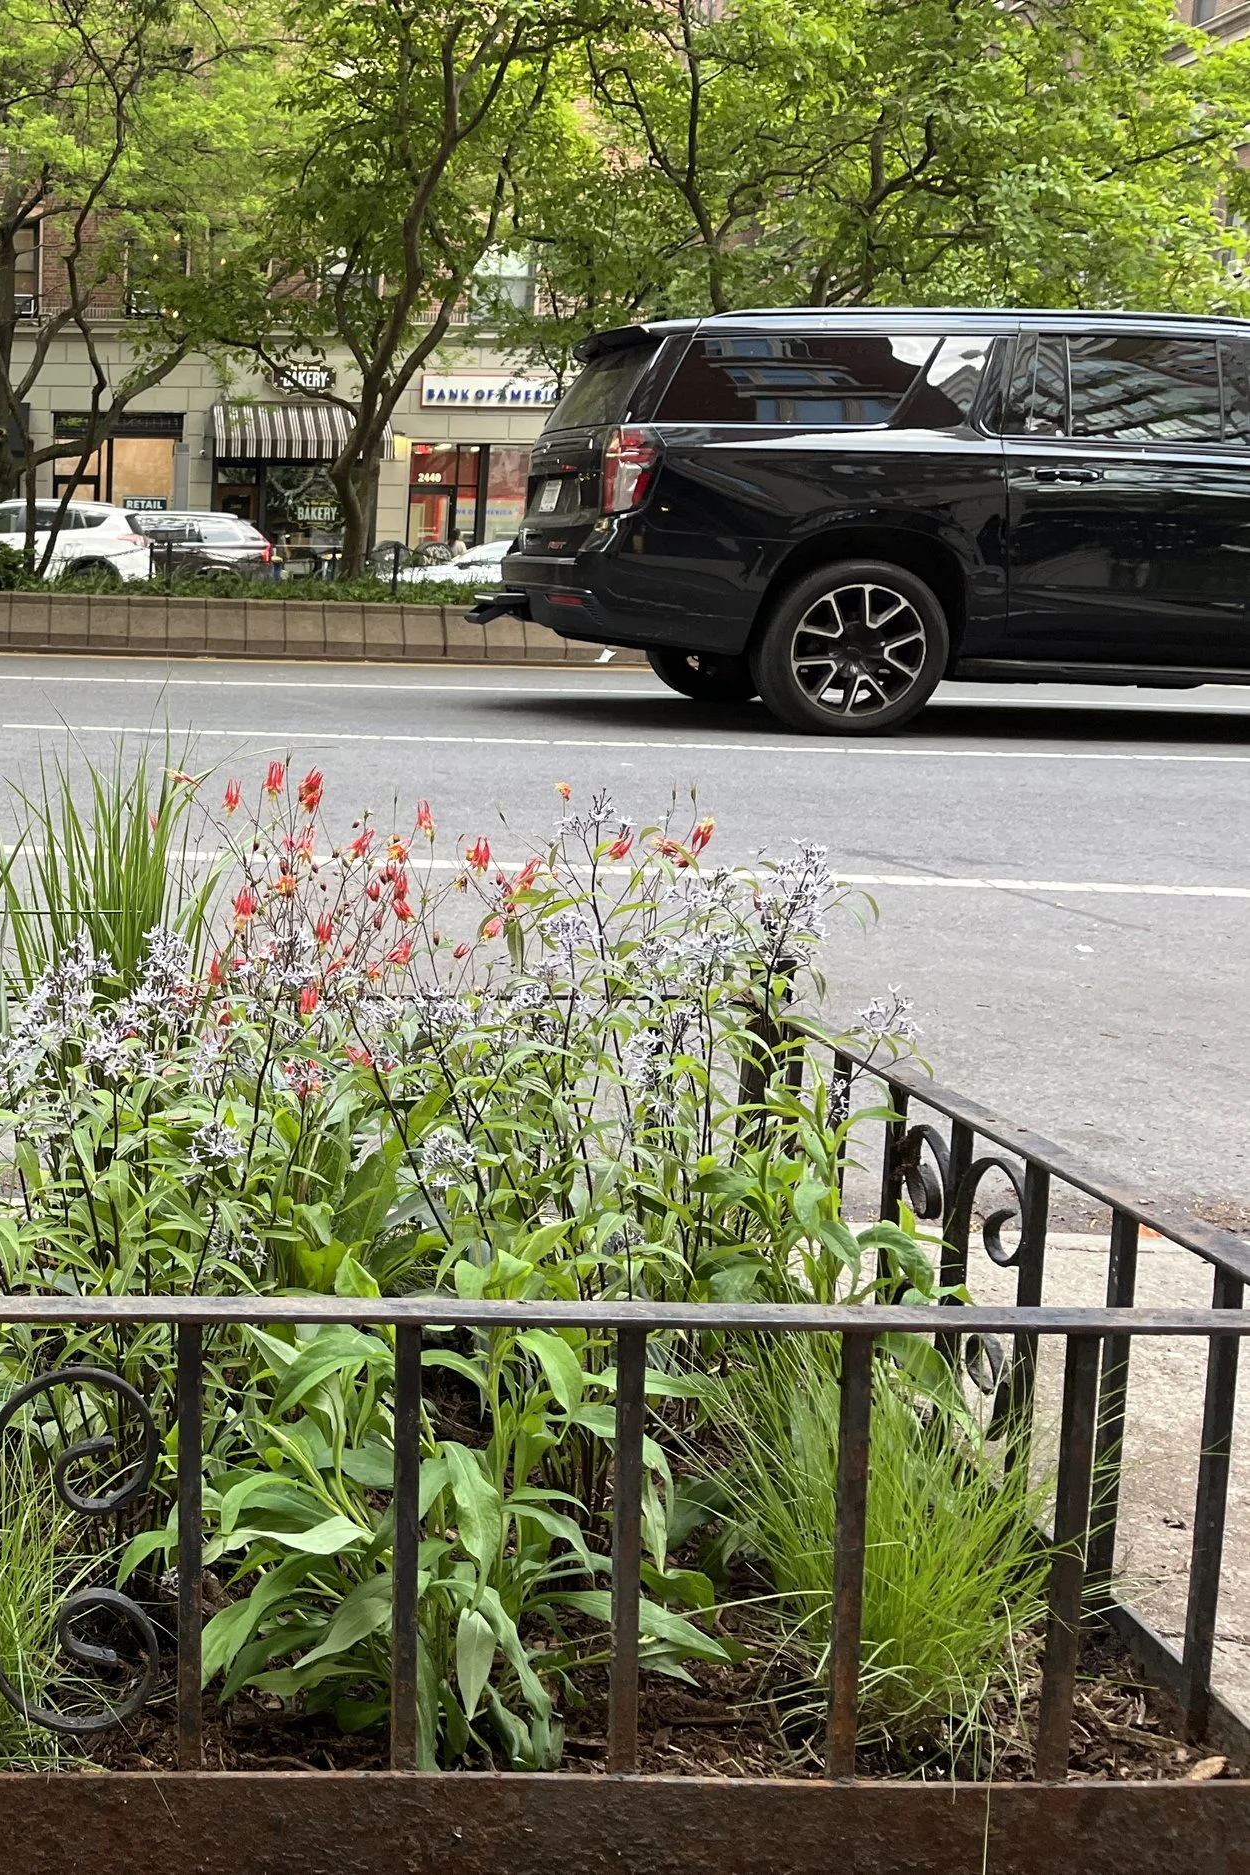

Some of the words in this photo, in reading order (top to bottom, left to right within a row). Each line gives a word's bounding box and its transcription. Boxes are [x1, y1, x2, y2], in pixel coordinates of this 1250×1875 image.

[427, 388, 469, 401] BANK
[475, 389, 495, 401] OF
[498, 388, 560, 402] AMERIC
[417, 472, 442, 483] 2440
[126, 500, 163, 509] RETAIL
[297, 506, 338, 521] BAKERY
